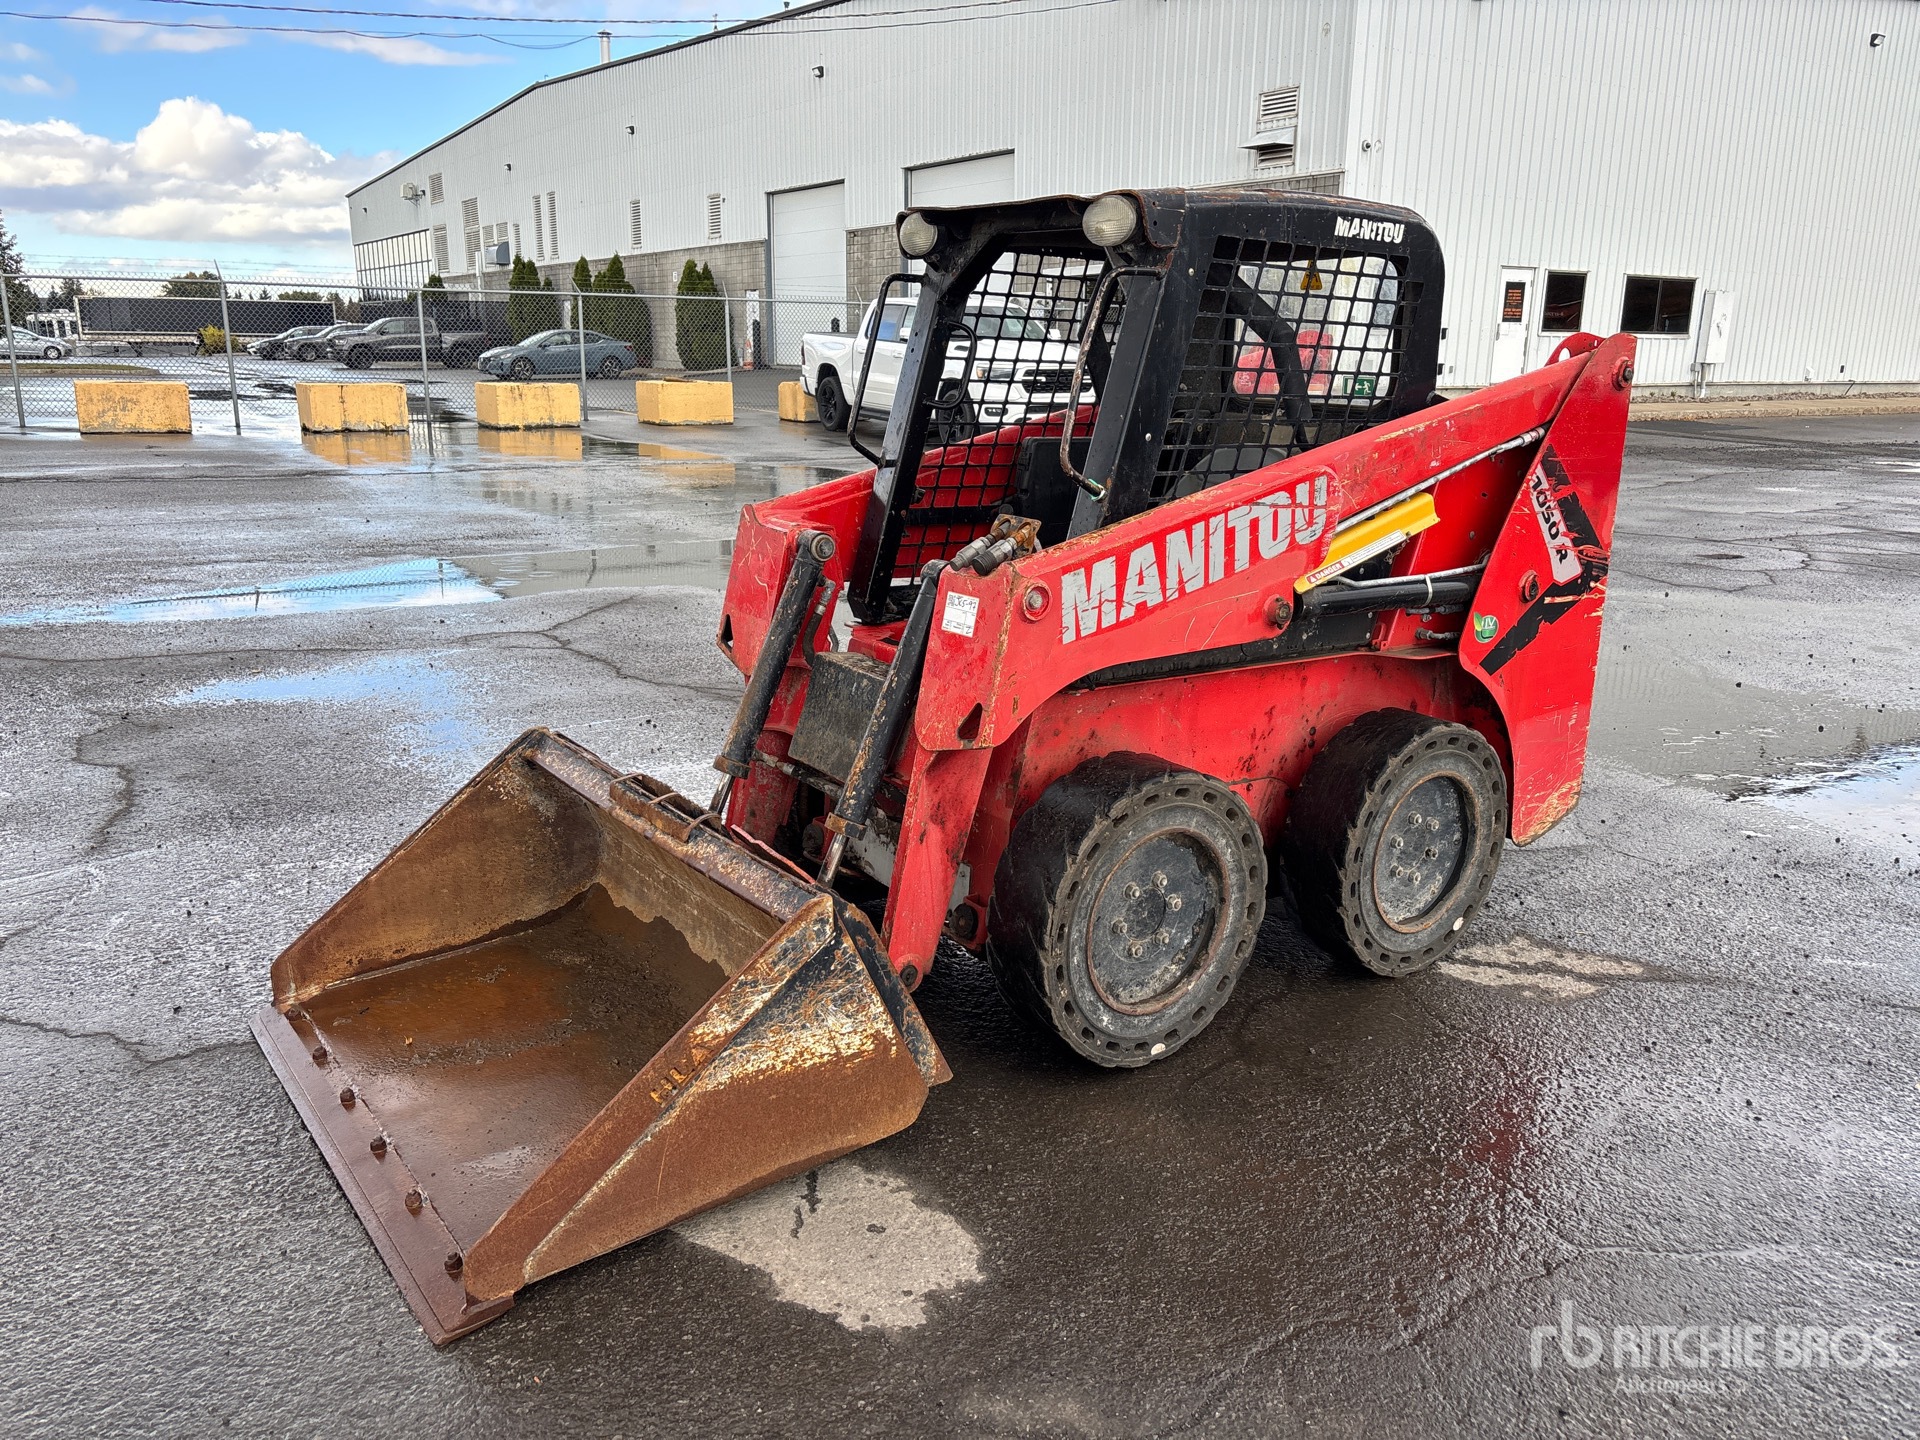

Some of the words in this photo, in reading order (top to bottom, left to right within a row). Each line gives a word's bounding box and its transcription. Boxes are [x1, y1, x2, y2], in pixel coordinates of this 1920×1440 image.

[1334, 215, 1405, 244] MANITOU
[1530, 474, 1560, 541] 1050
[1061, 474, 1329, 646] MANITOU
[1315, 562, 1343, 581] DANGER
